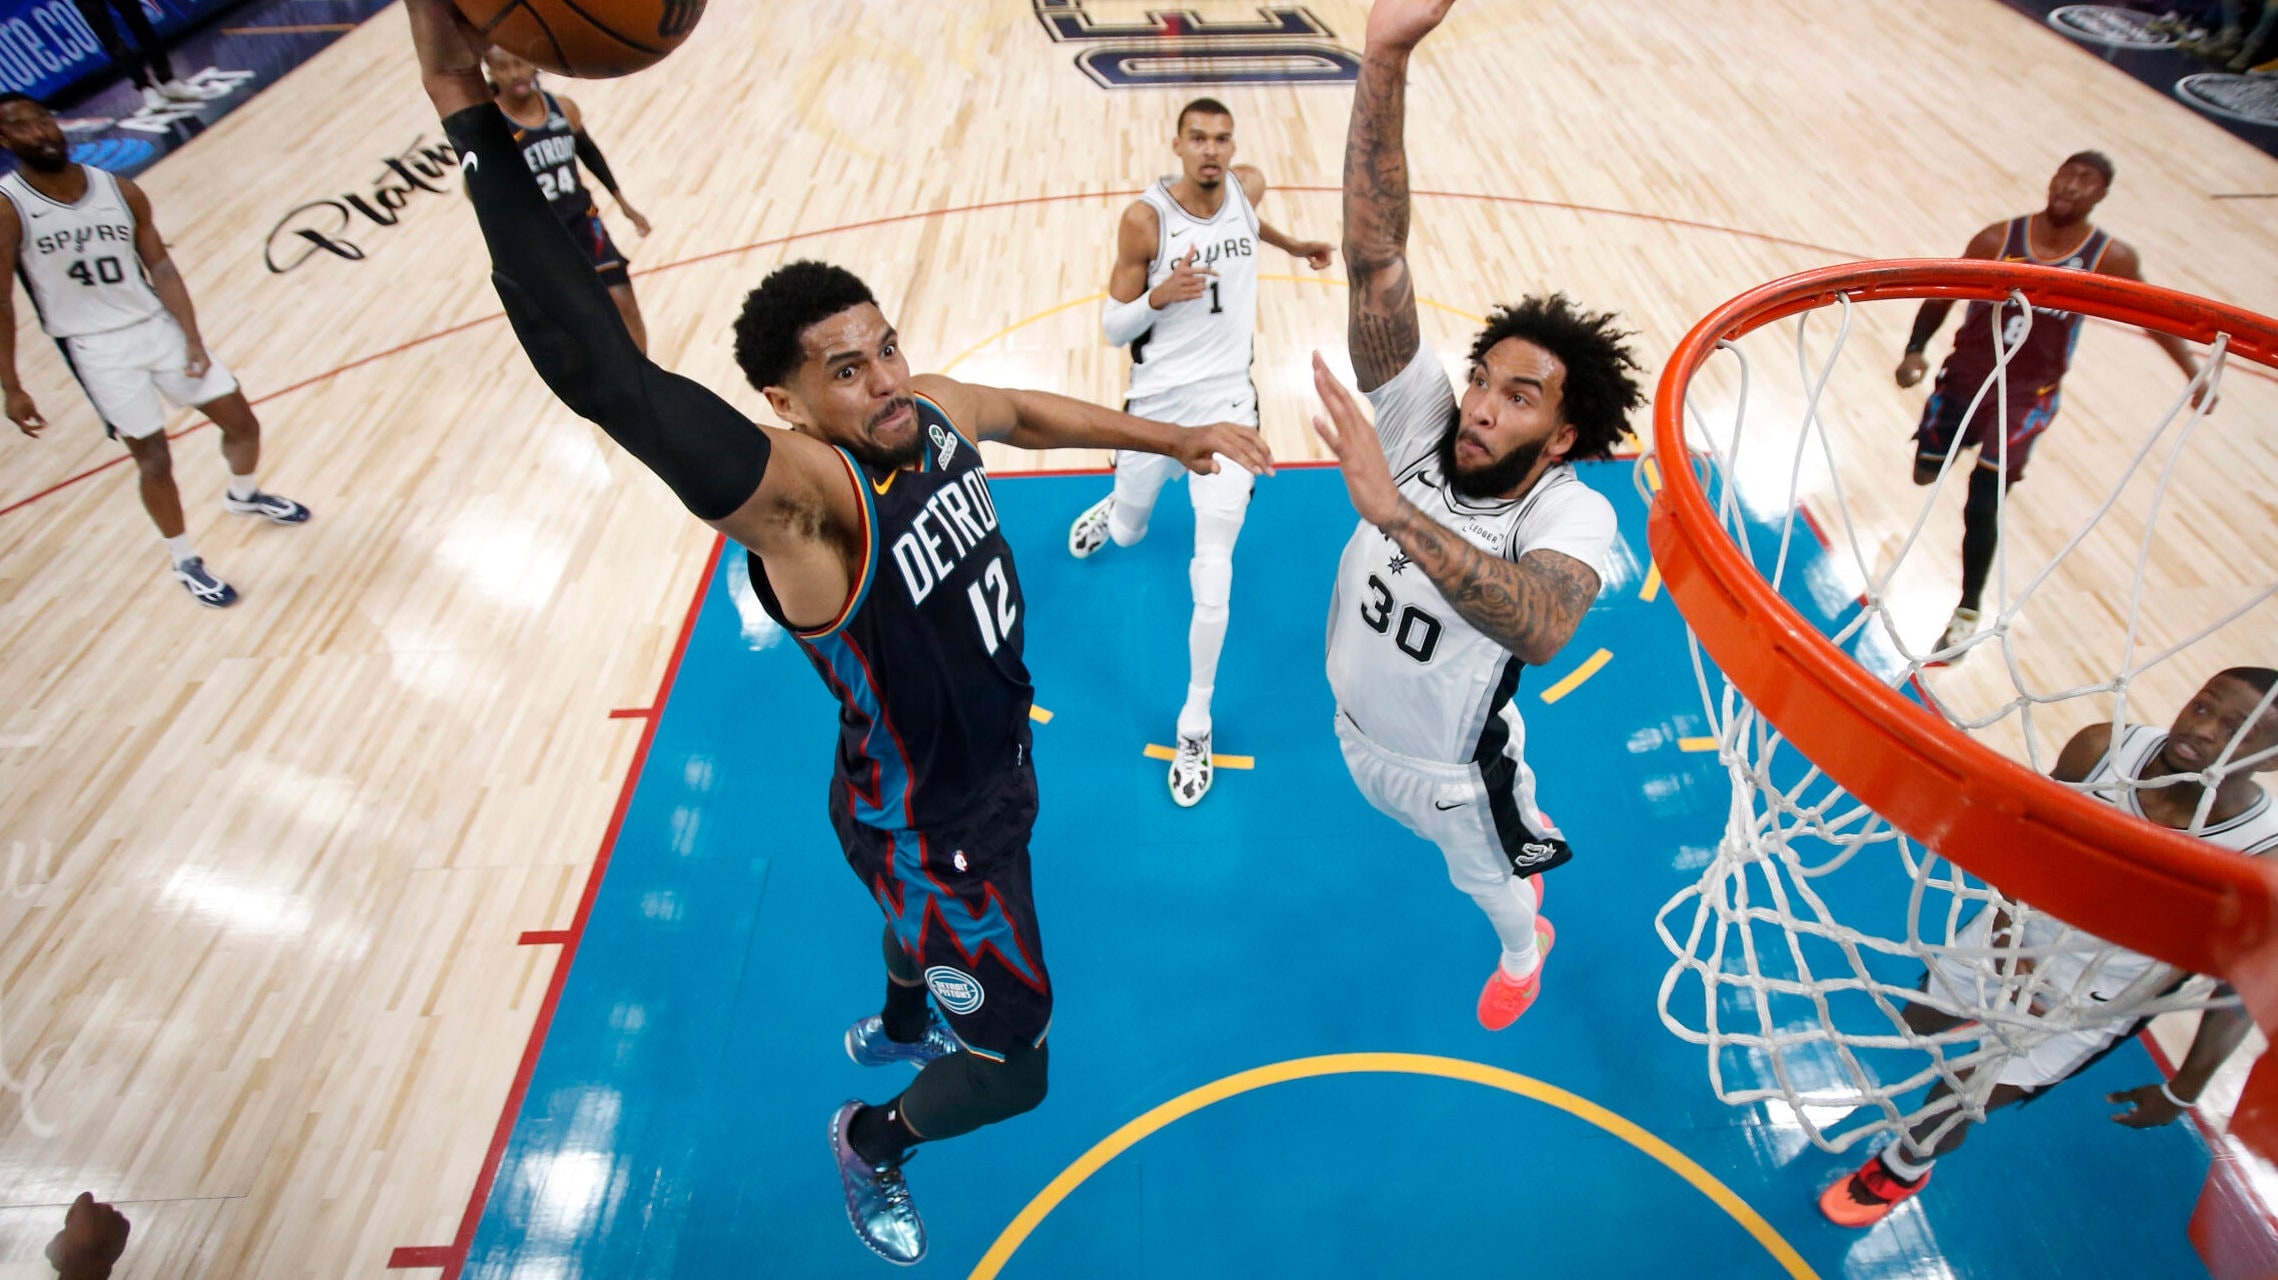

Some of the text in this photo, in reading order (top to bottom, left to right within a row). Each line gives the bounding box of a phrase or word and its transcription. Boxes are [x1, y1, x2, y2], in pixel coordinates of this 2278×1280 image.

[536, 165, 576, 201] 24
[36, 223, 130, 254] SPURS
[66, 256, 124, 287] 40
[1210, 280, 1223, 314] 1
[1469, 523, 1498, 544] LEDGER
[967, 557, 1016, 657] 12
[1360, 572, 1444, 664] 30
